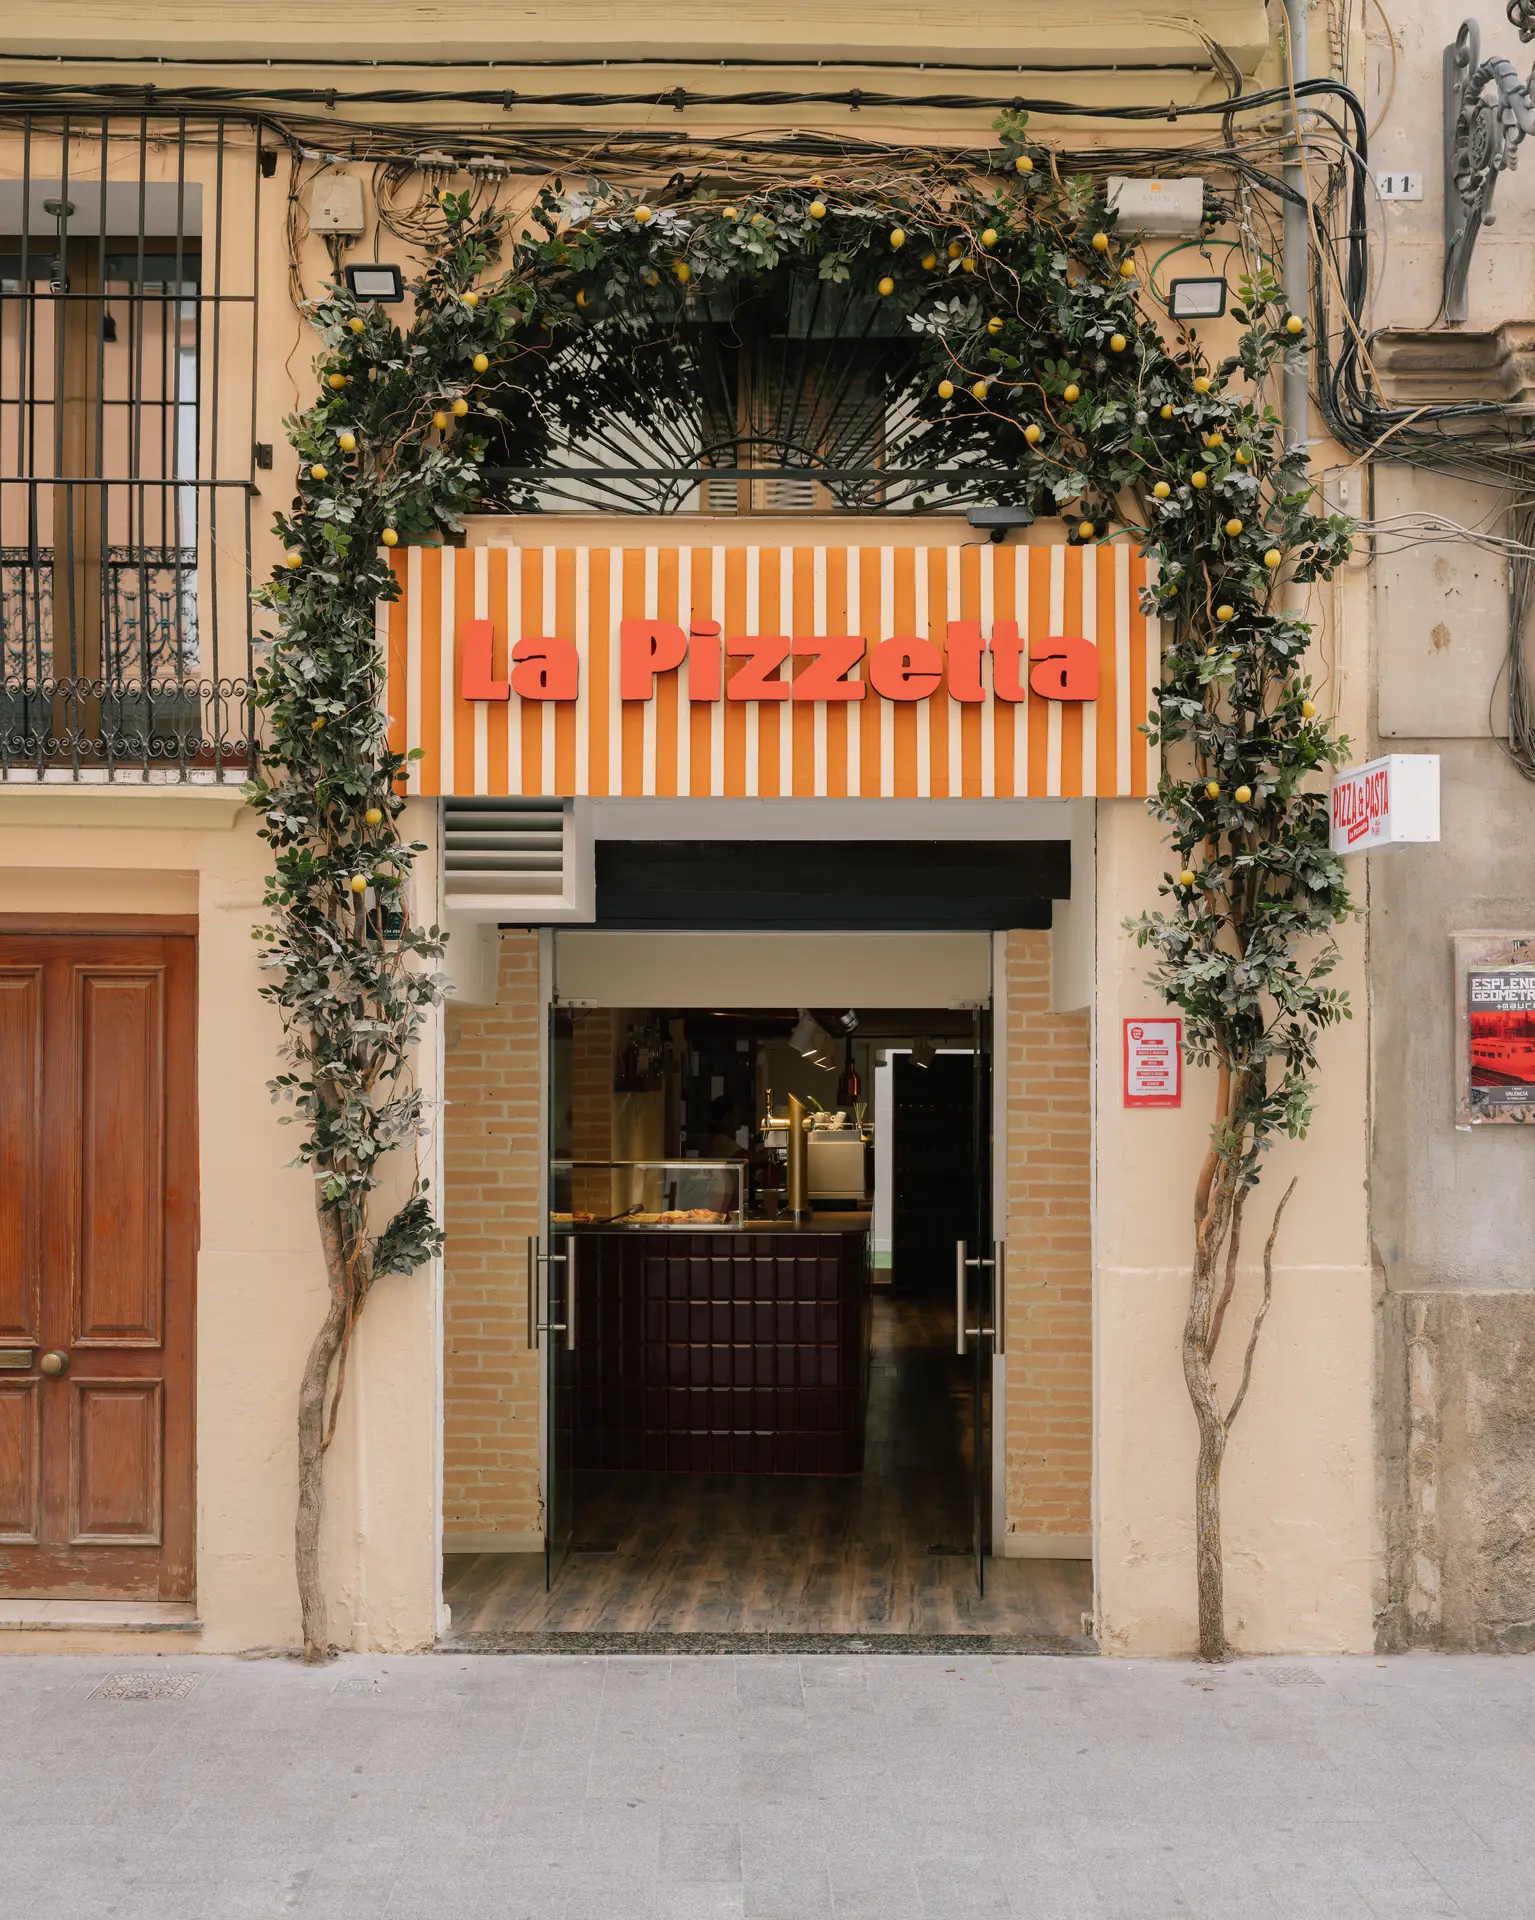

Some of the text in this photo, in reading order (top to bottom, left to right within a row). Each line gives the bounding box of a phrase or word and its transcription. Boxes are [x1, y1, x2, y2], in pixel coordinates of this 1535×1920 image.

[462, 619, 1098, 702] La Pizzetta
[1333, 770, 1389, 829] PIZZA & PASTA
